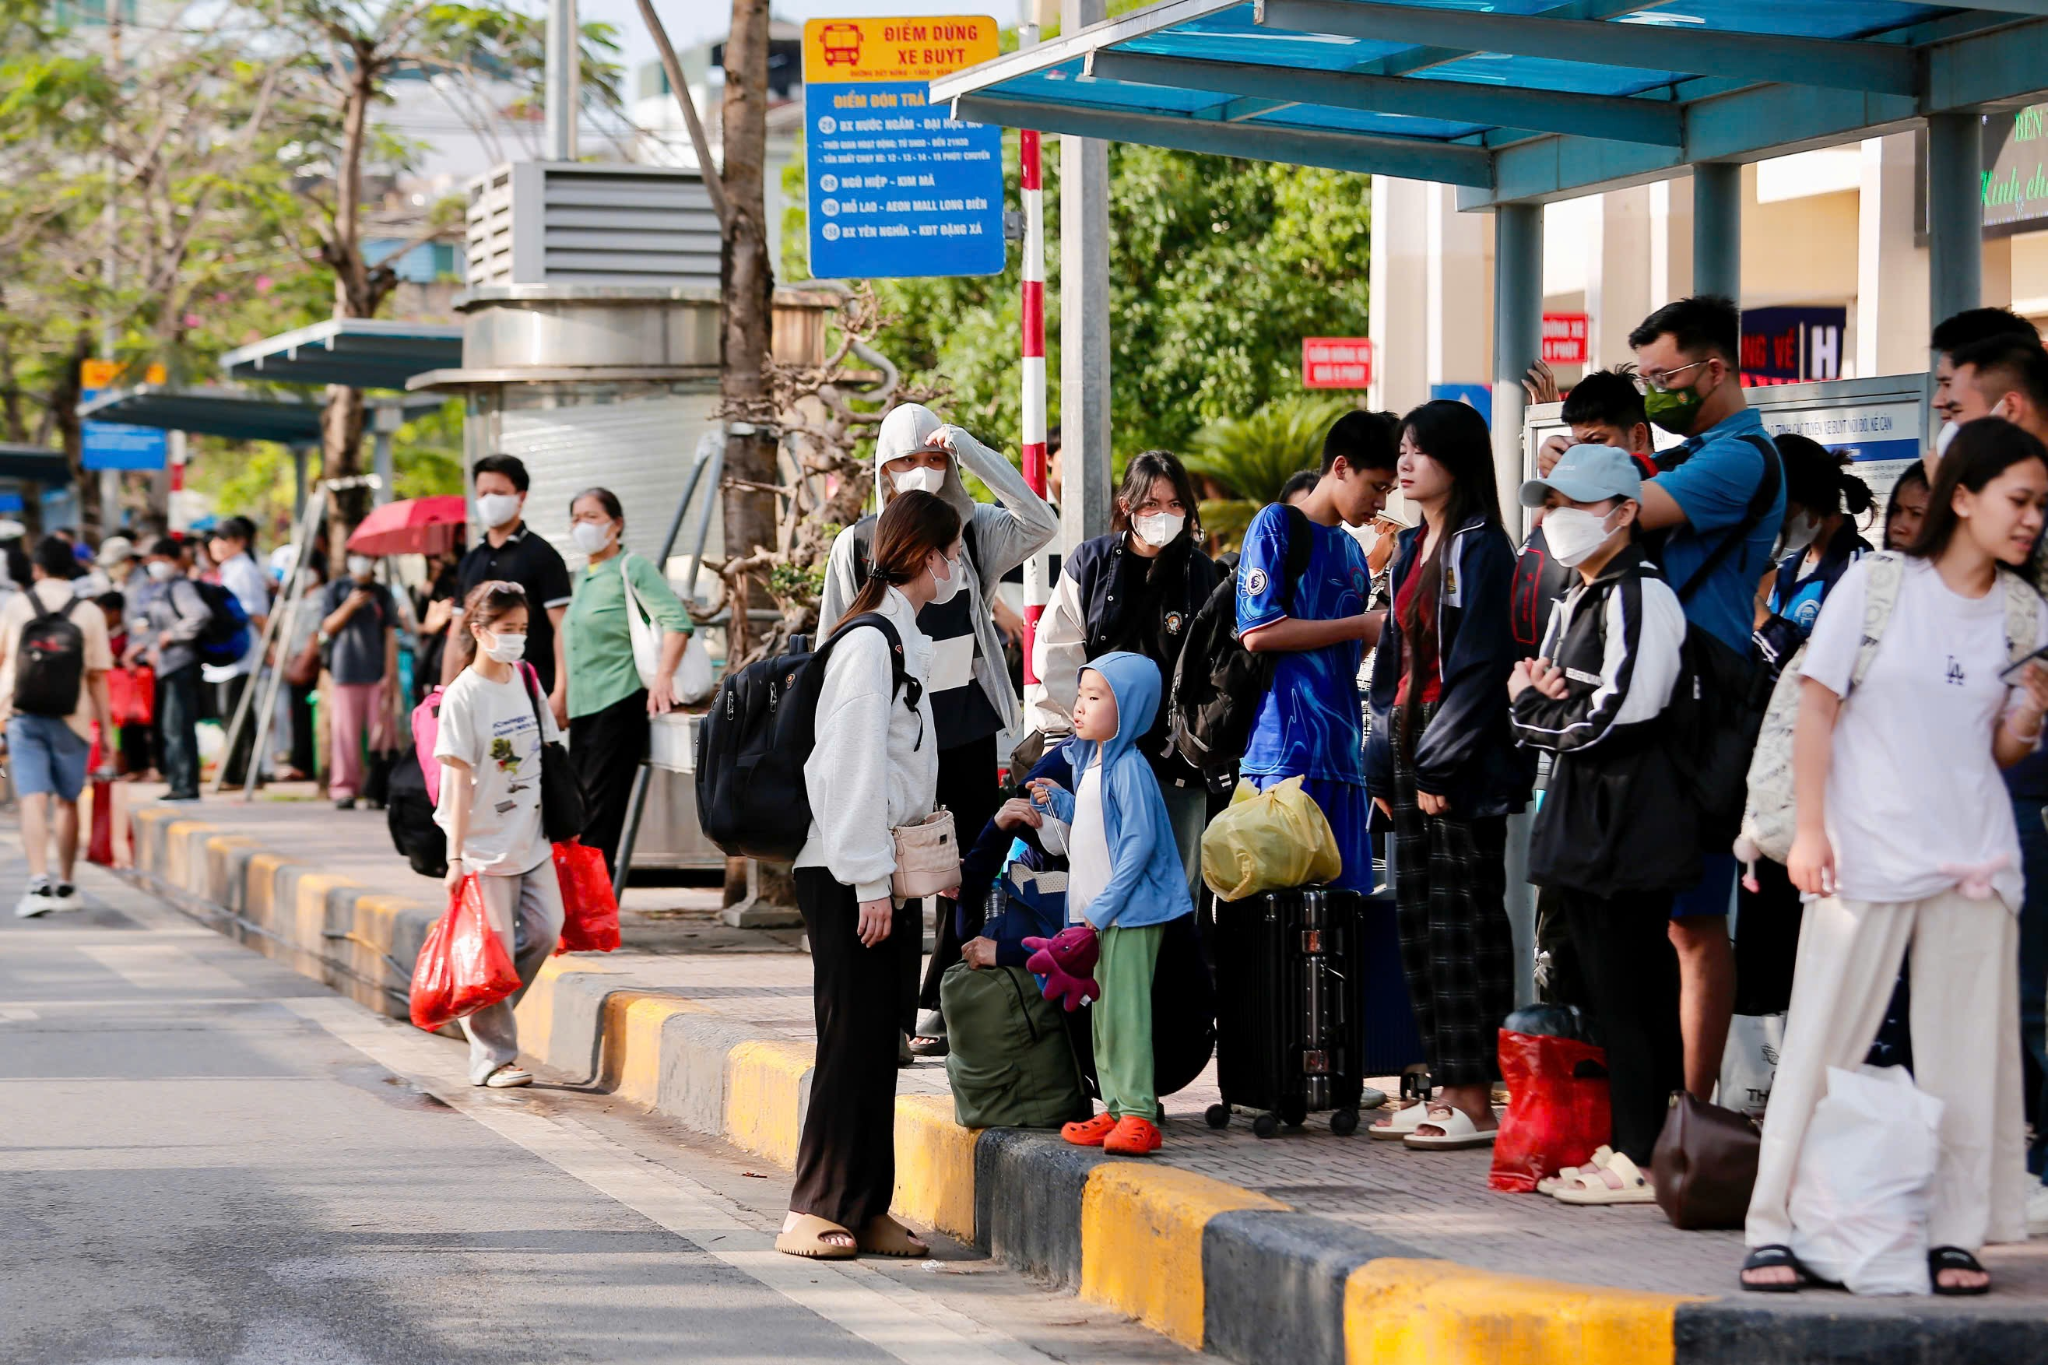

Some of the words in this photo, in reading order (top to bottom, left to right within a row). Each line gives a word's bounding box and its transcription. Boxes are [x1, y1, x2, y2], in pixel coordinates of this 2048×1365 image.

[884, 20, 926, 42] ĐIỂM
[932, 21, 978, 41] DỪNG
[897, 49, 917, 65] XE
[923, 46, 966, 64] BUÝT
[833, 88, 867, 109] ĐIỂM
[870, 90, 897, 108] ĐÓN
[900, 88, 926, 107] TRẢ
[839, 120, 854, 131] BX
[923, 117, 940, 132] ĐẠI
[897, 175, 916, 187] KIM
[858, 201, 877, 213] LAO
[886, 201, 911, 213] AEON
[912, 200, 938, 212] MALL
[938, 199, 964, 211] LONG
[965, 196, 988, 210] BIÊN
[842, 226, 857, 238] BX
[1823, 420, 1832, 435] XE
